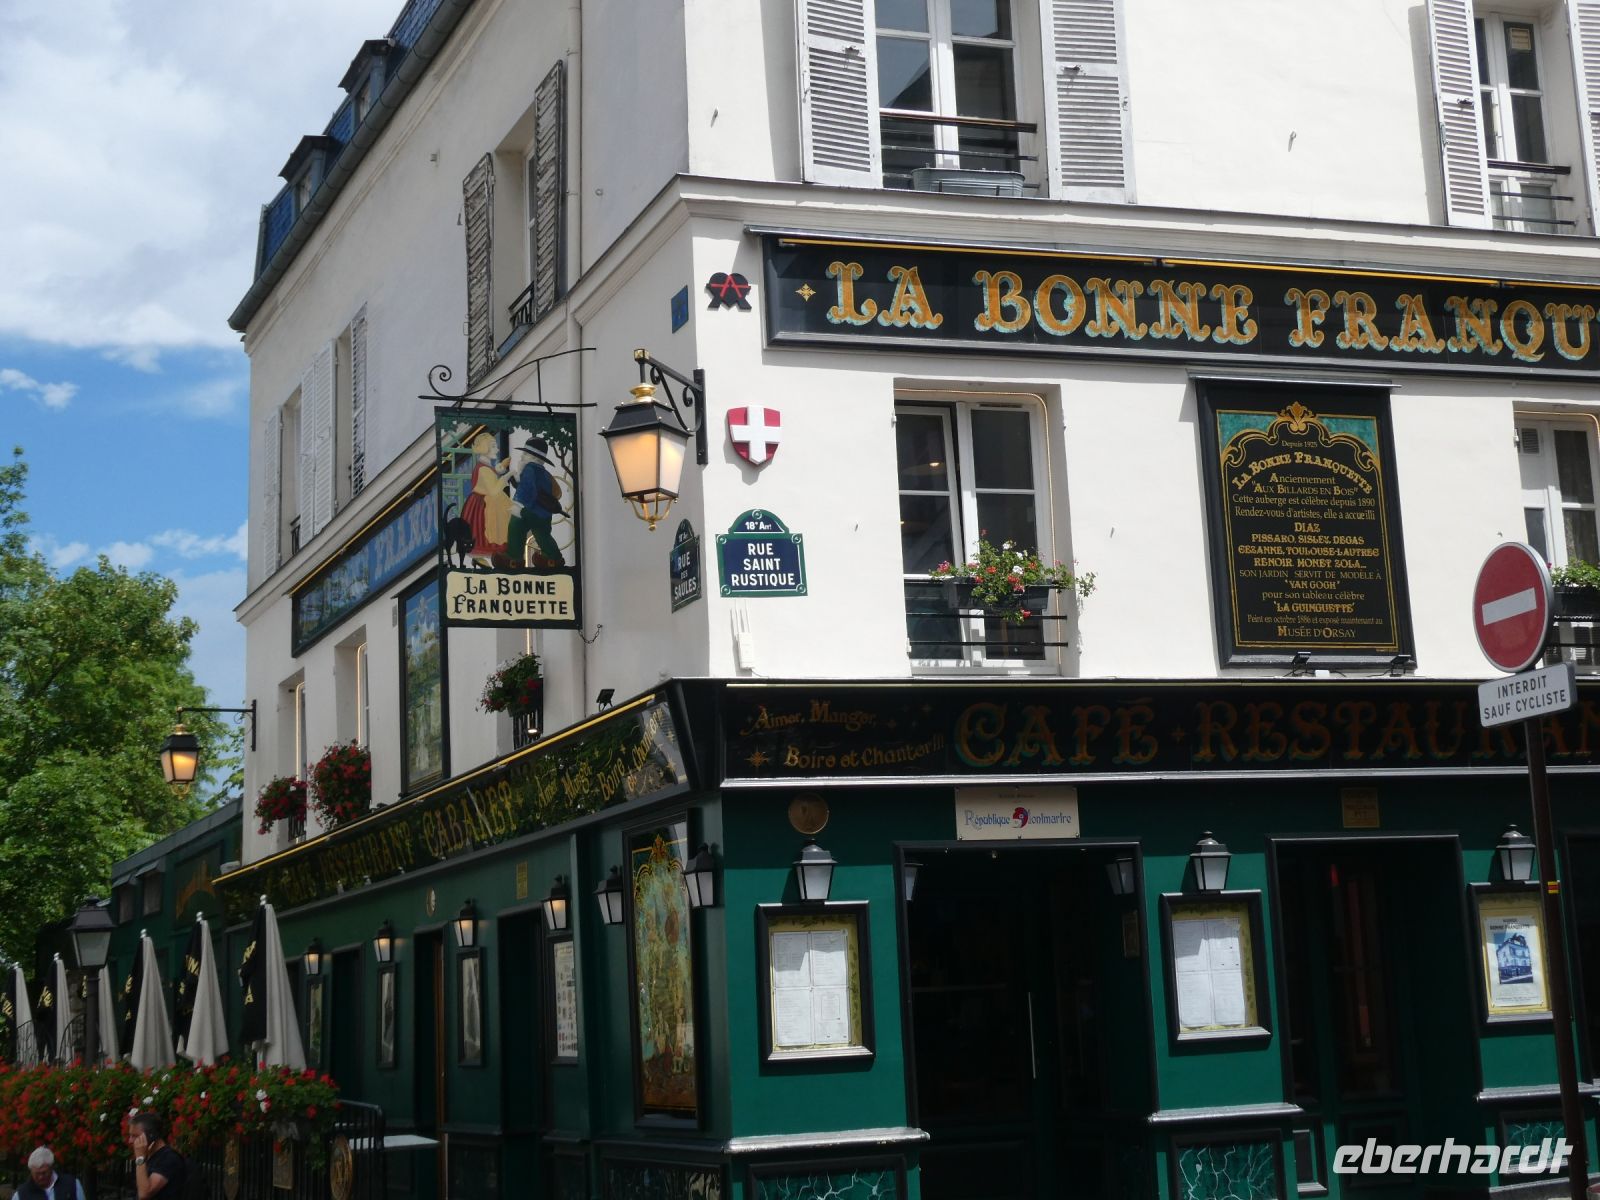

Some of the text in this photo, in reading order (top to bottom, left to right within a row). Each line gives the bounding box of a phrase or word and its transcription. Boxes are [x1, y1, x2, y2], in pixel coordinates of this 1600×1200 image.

[825, 261, 1600, 363] LA BONNE FRANQU
[1282, 440, 1303, 449] Depuis
[1232, 451, 1373, 494] LA BONNE FRANQUETTE
[1269, 473, 1336, 485] Anciennement
[1277, 484, 1319, 496] BILLARDS
[1320, 486, 1332, 496] EN
[1232, 493, 1375, 508] Cette auberge est célèbre depuis 1890
[1235, 506, 1375, 520] Rendez-vous d'artistes, elle a accueilli
[1294, 521, 1320, 533] DIAZ
[1333, 535, 1365, 545] DEGAS
[747, 543, 774, 556] RUE
[1286, 545, 1380, 557] TOULOUSE-LAUTREC
[677, 551, 691, 571] RUE
[743, 558, 781, 571] SAINT
[731, 573, 796, 587] RUSTIQUE
[1239, 569, 1257, 578] SON
[1258, 569, 1289, 578] JARDIN
[1294, 570, 1322, 579] SERVIT
[1325, 571, 1336, 579] DE
[464, 576, 556, 597] LA BONNE
[674, 576, 697, 601] SAULES
[1262, 591, 1282, 601] pour
[1284, 591, 1300, 599] son
[1302, 590, 1333, 600] tableau
[452, 593, 568, 616] FRANQUETTE
[1247, 613, 1263, 623] Peint
[1264, 615, 1272, 623] en
[1313, 627, 1357, 638] D'ORSAY
[1497, 675, 1547, 699] INTERDIT
[1484, 689, 1567, 720] SAUF CYCLISTE
[953, 696, 1159, 768] CAFÉ
[784, 744, 836, 769] Boire
[840, 750, 860, 768] et
[597, 757, 625, 801] Boire
[964, 809, 1010, 831] République
